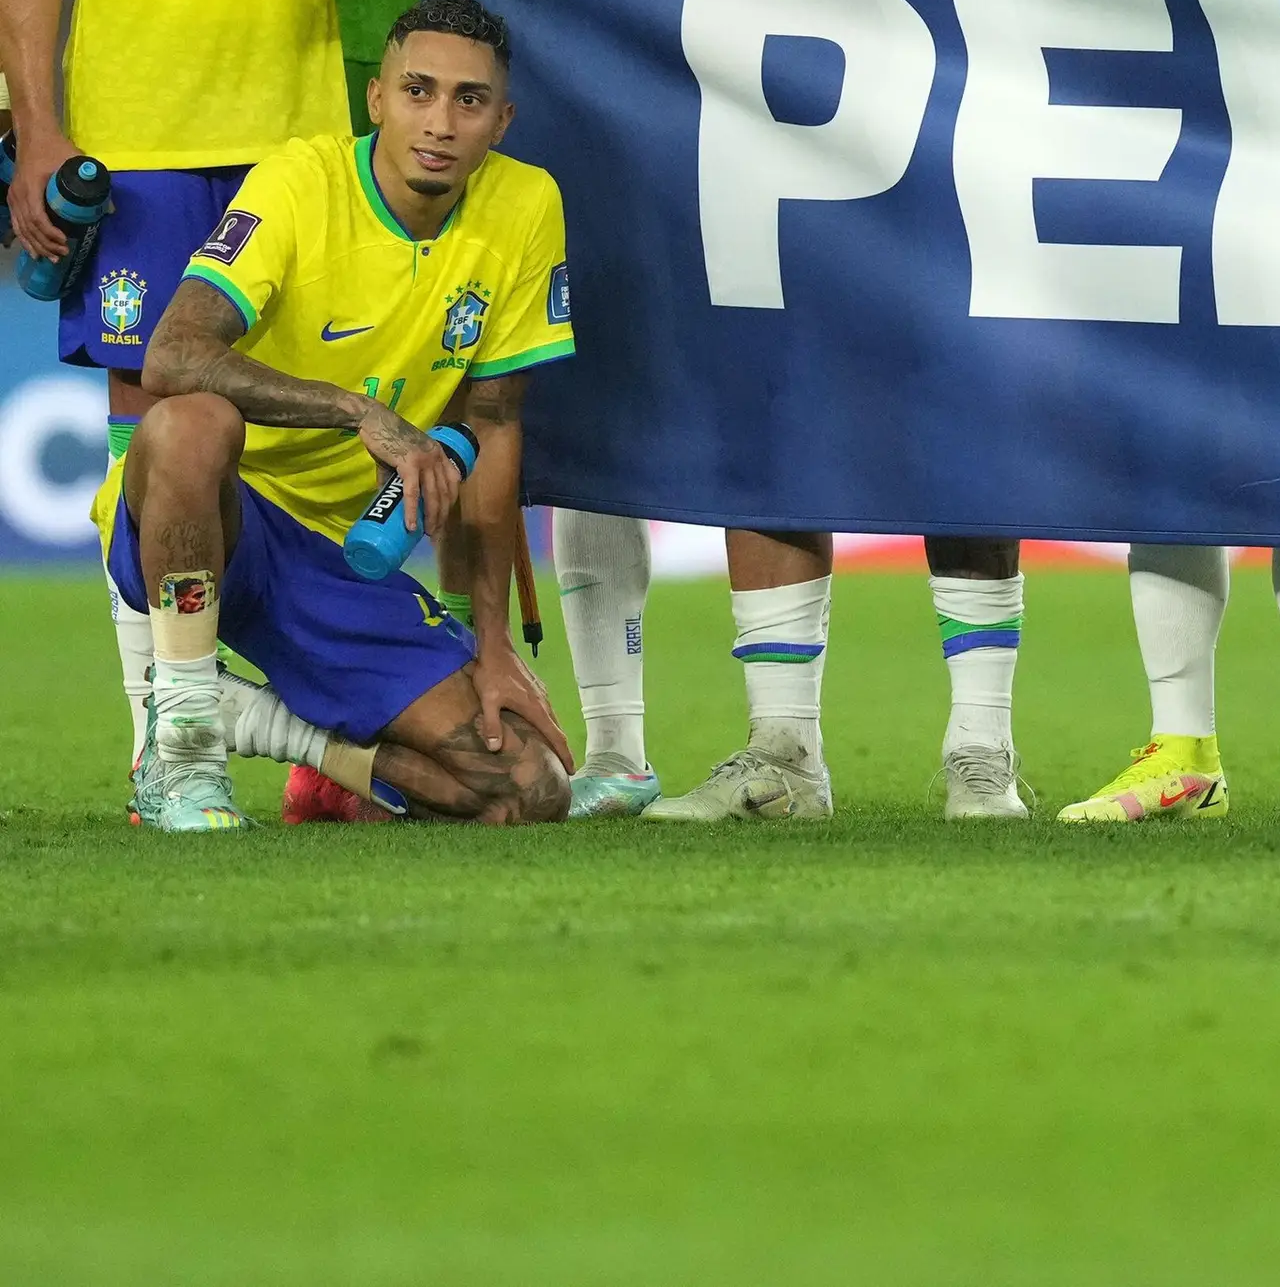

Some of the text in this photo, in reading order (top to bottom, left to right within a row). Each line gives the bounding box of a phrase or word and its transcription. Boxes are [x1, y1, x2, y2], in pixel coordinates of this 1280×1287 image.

[113, 300, 130, 308] CBF
[452, 315, 469, 327] CBF
[101, 333, 143, 346] BRASIL
[430, 356, 470, 373] BRASI
[369, 477, 403, 519] POWE
[625, 613, 642, 655] BRASIL
